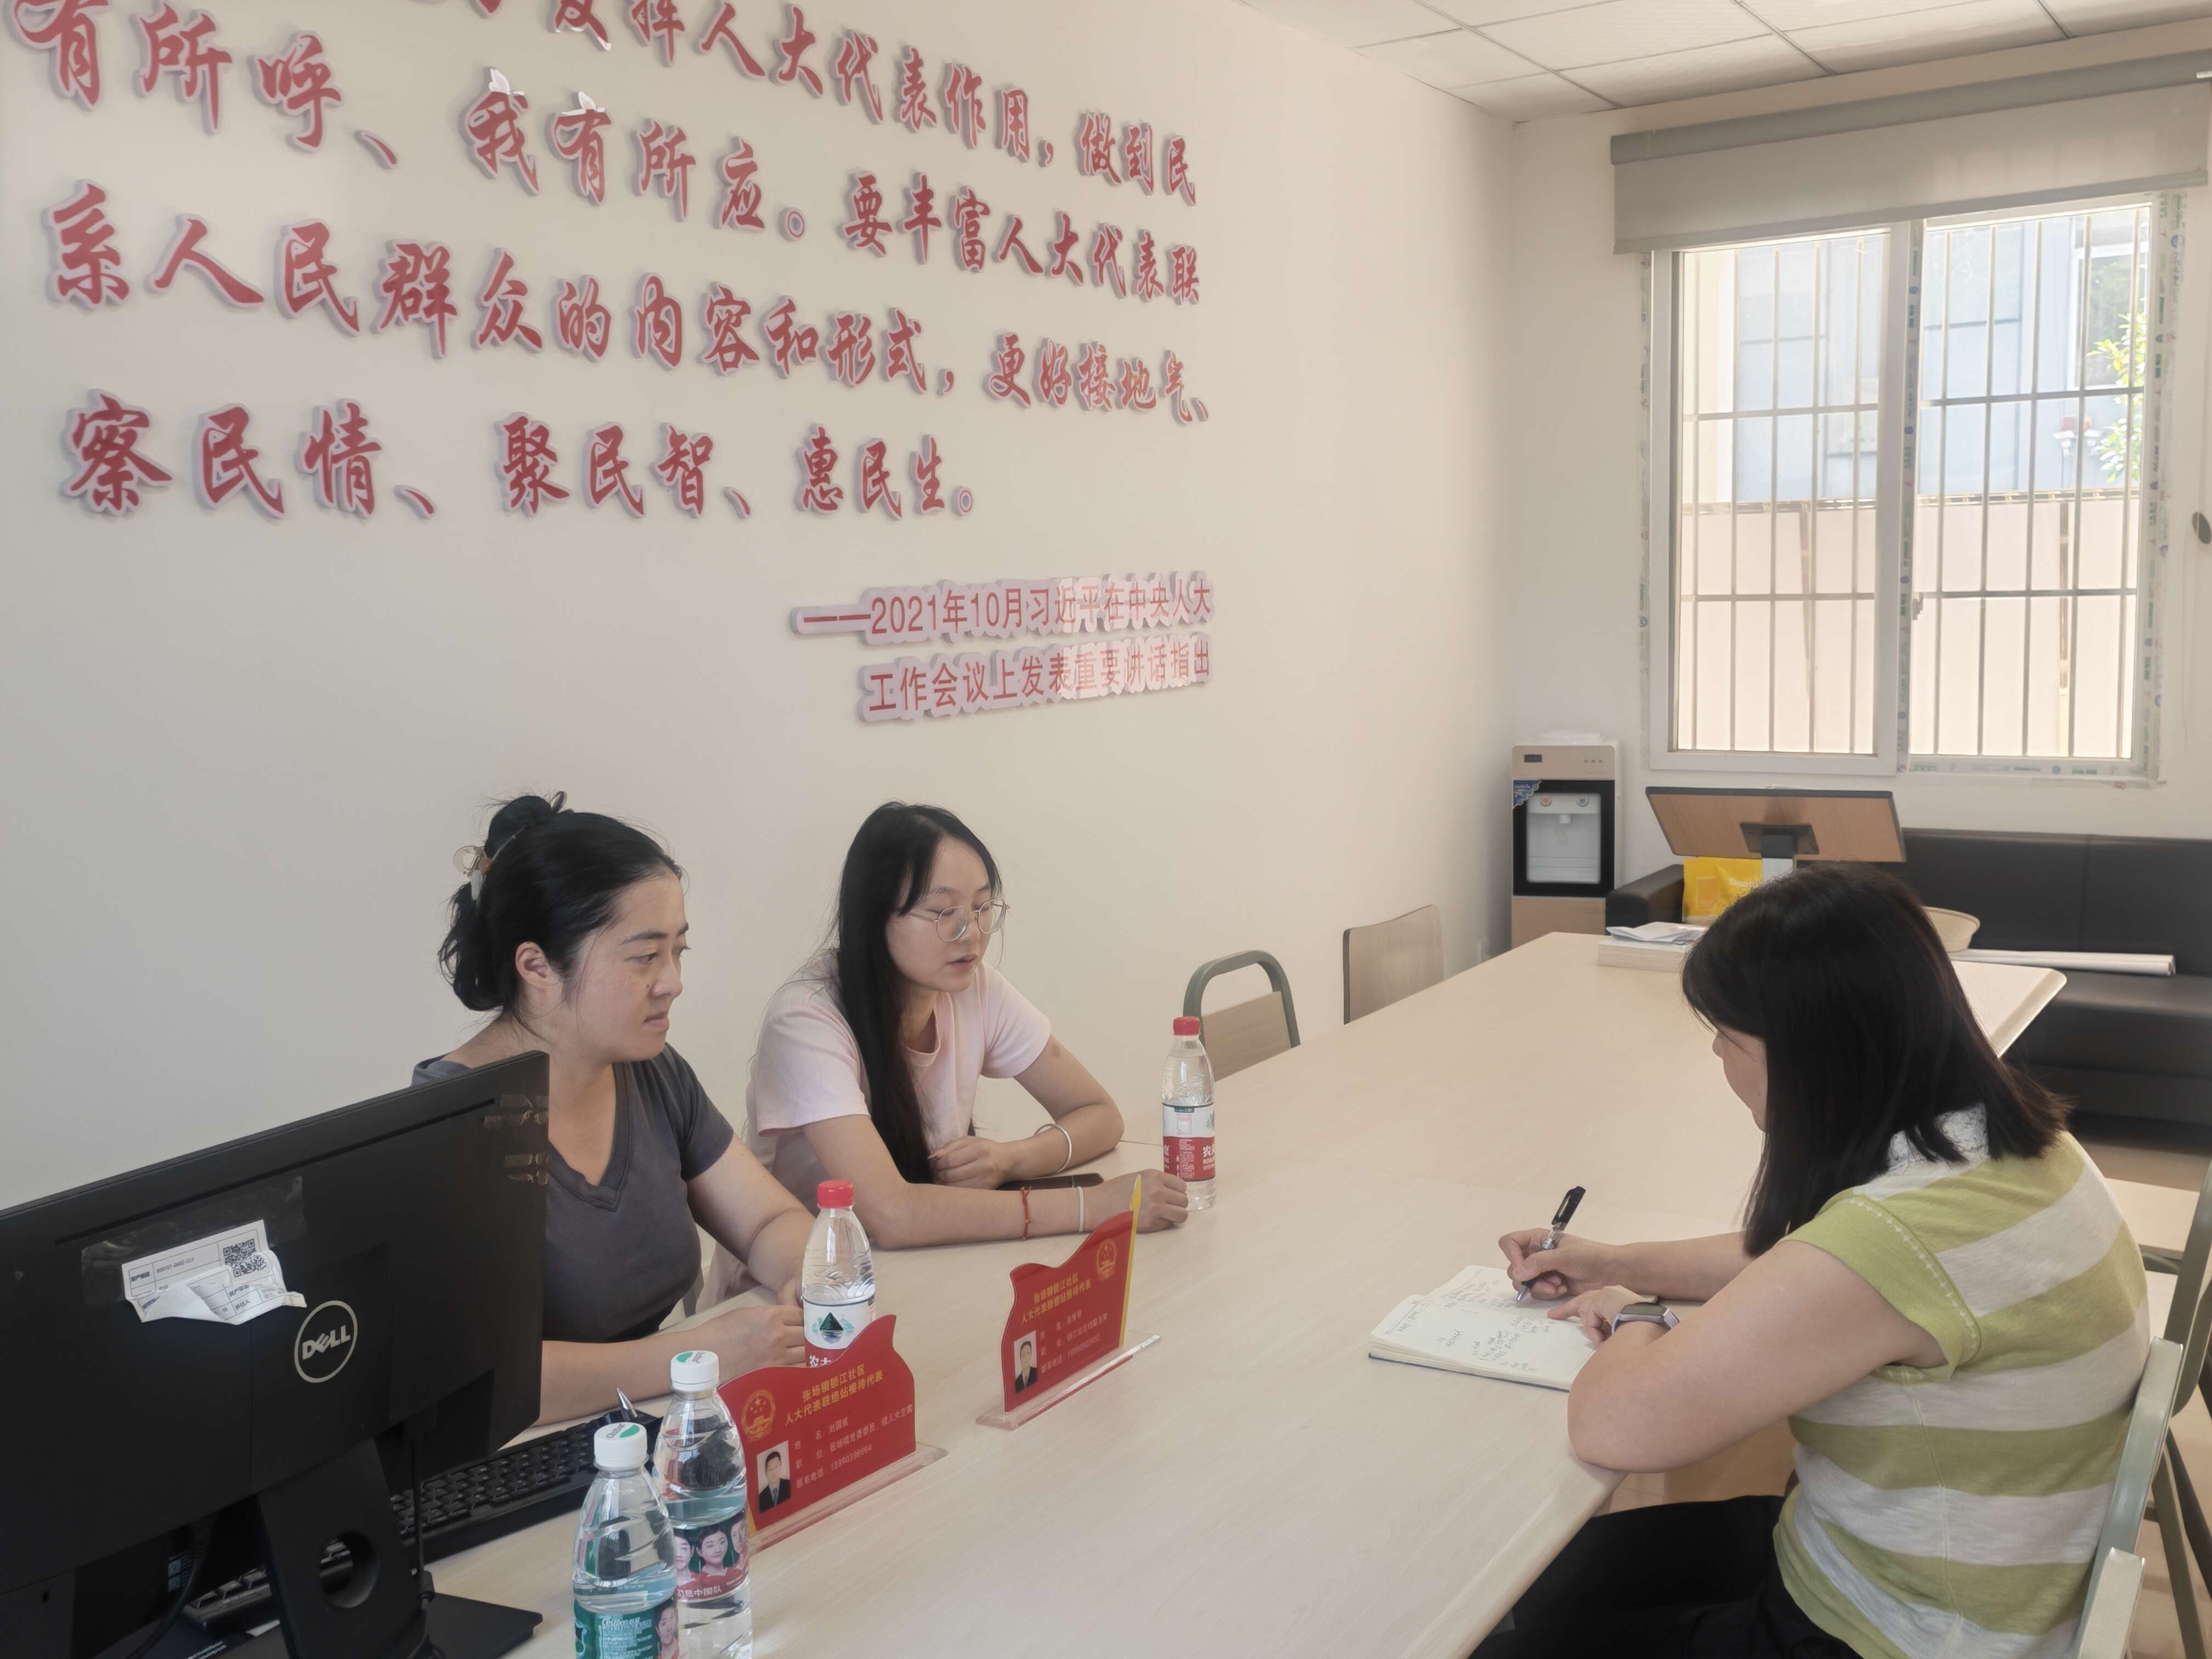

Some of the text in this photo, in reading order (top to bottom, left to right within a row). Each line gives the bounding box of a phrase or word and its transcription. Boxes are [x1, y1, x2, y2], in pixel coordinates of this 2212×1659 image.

[869, 642, 1210, 712] 工作会议上发表重要讲话指出
[302, 1324, 351, 1360] DELL
